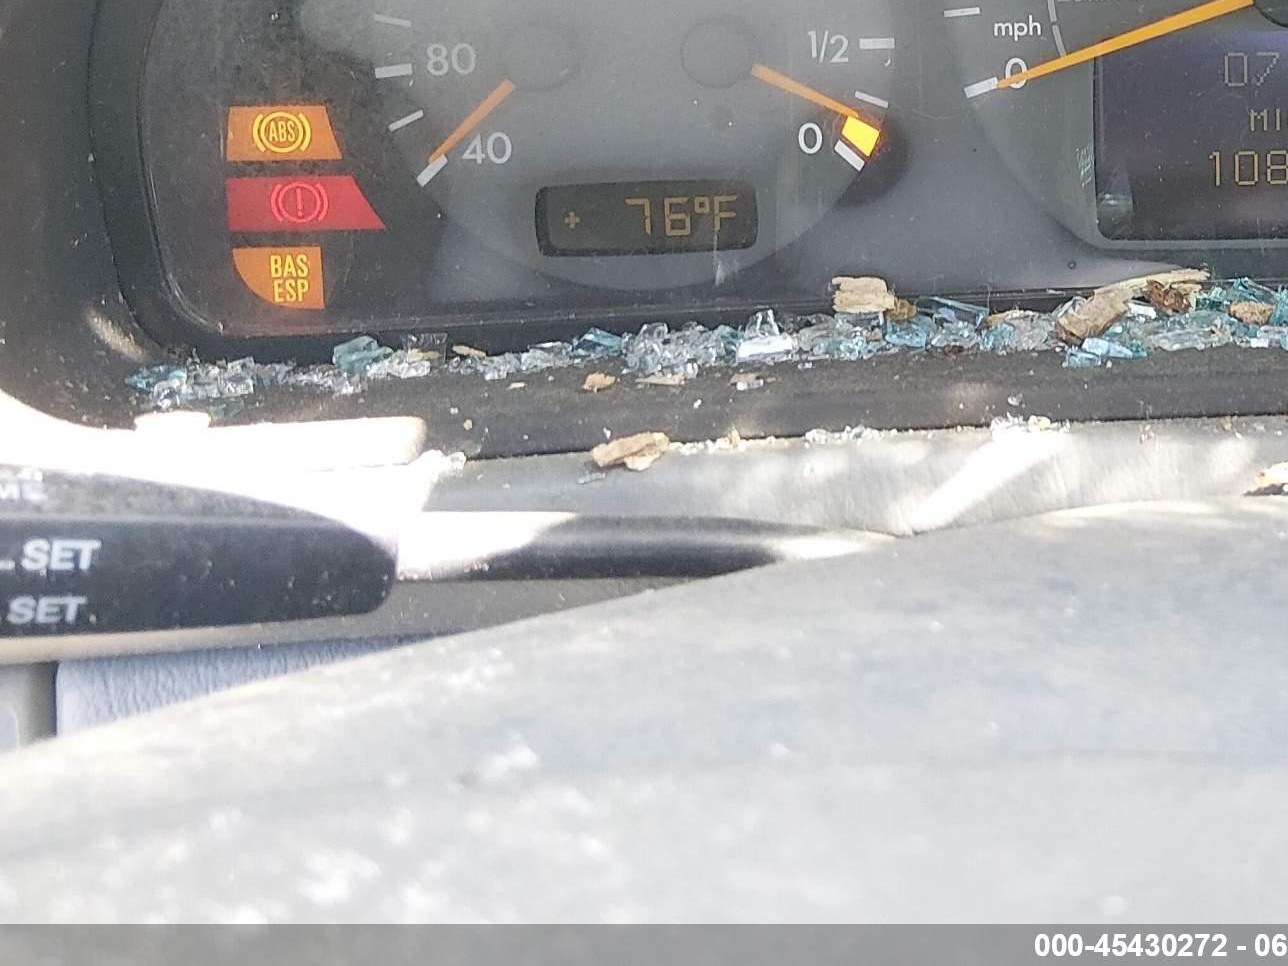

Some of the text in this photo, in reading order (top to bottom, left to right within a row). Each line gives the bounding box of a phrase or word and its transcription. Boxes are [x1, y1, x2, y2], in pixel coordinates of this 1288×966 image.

[993, 17, 1041, 41] mph
[426, 43, 476, 76] 80
[809, 30, 850, 64] 1/2
[1005, 58, 1028, 89] 0
[268, 120, 296, 142] ABS
[798, 123, 822, 154] 0
[462, 133, 512, 164] 40
[270, 255, 308, 278] BAS
[273, 280, 309, 302] ESP
[22, 539, 101, 569] SET
[7, 596, 87, 624] SET
